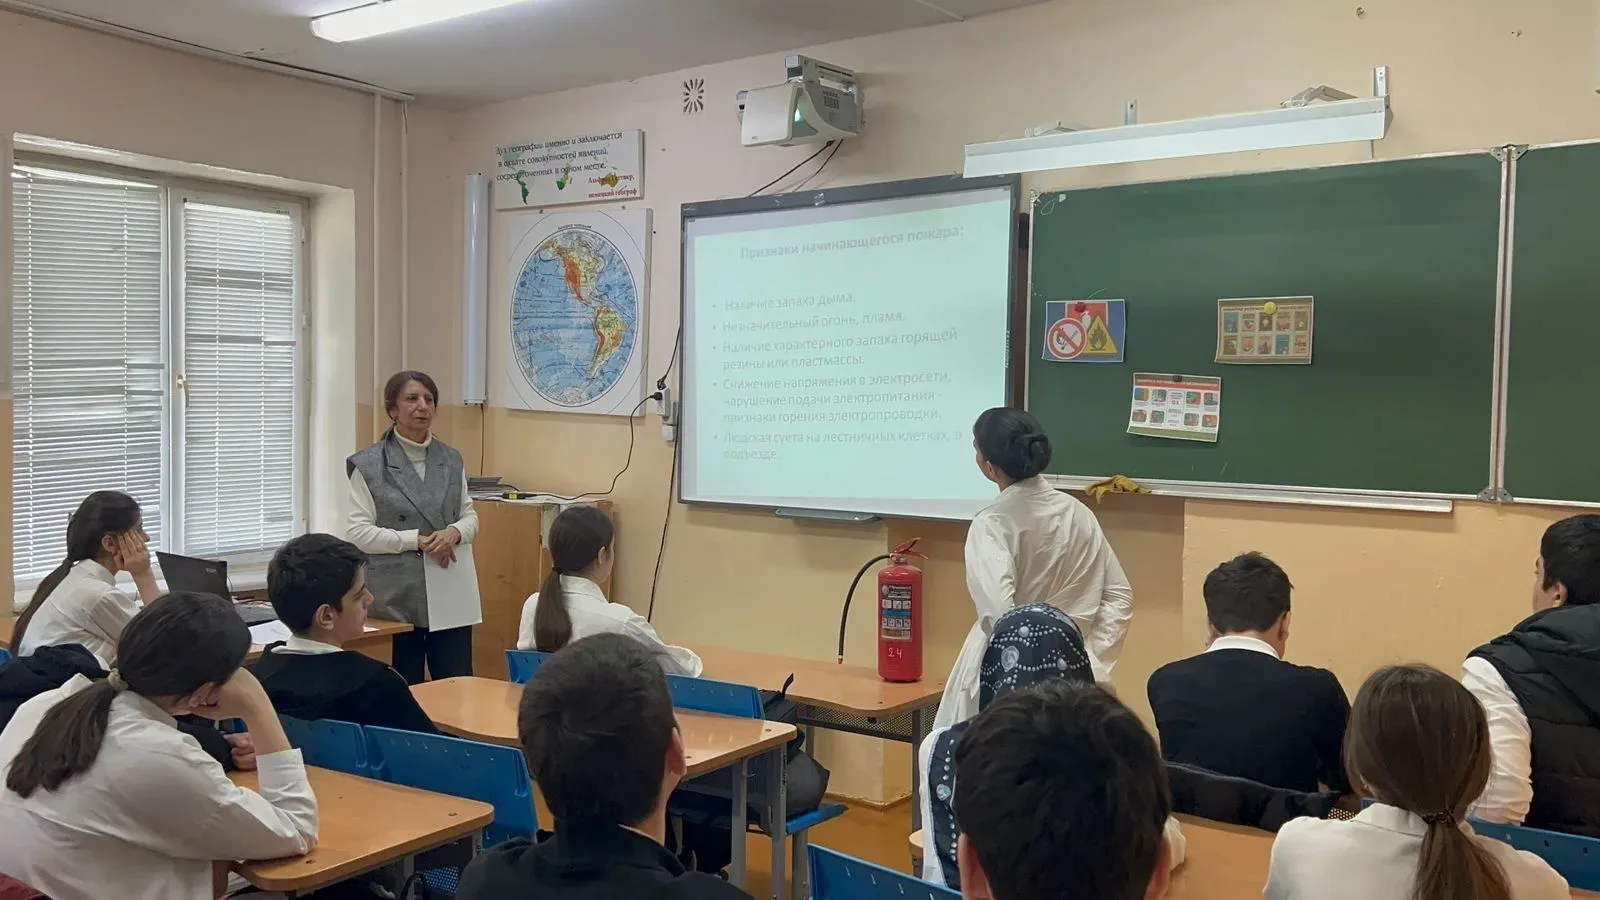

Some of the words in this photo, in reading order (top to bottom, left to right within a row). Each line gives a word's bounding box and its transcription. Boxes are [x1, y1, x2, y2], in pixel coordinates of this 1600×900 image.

[545, 140, 570, 148] именно
[577, 132, 624, 144] заключается
[527, 150, 577, 164] совокупностей
[578, 146, 609, 158] явлений,
[584, 162, 607, 171] месте.
[741, 245, 799, 261] Признаки
[801, 233, 904, 255] начинающегося
[907, 225, 964, 243] пожара:
[725, 299, 774, 311] Наличие
[776, 296, 815, 308] запаха
[817, 292, 856, 306] дыма.
[722, 315, 819, 332] Незначительный
[821, 315, 859, 328] огонь,
[862, 311, 906, 324] пламя.
[722, 341, 770, 353] Наличие
[770, 336, 854, 354] характерного
[856, 334, 898, 347] запаха
[901, 327, 959, 346] горящей
[722, 359, 765, 372] резины
[767, 358, 788, 369] или
[791, 354, 865, 368] пластмассы.
[722, 378, 782, 390] Снижение
[783, 376, 856, 391] напряжения
[859, 375, 866, 385] в
[869, 371, 952, 387] электросети,
[722, 395, 787, 409] нарушение
[788, 393, 831, 407] подачи
[833, 390, 935, 405] электропитания
[722, 413, 776, 425] признаки
[779, 412, 826, 424] горения
[828, 409, 942, 423] электропроводки.
[723, 431, 771, 444] Людская
[773, 432, 804, 445] суета
[806, 432, 820, 443] на
[823, 431, 896, 443] лестничных
[898, 430, 951, 442] клетках,
[954, 430, 963, 441] в
